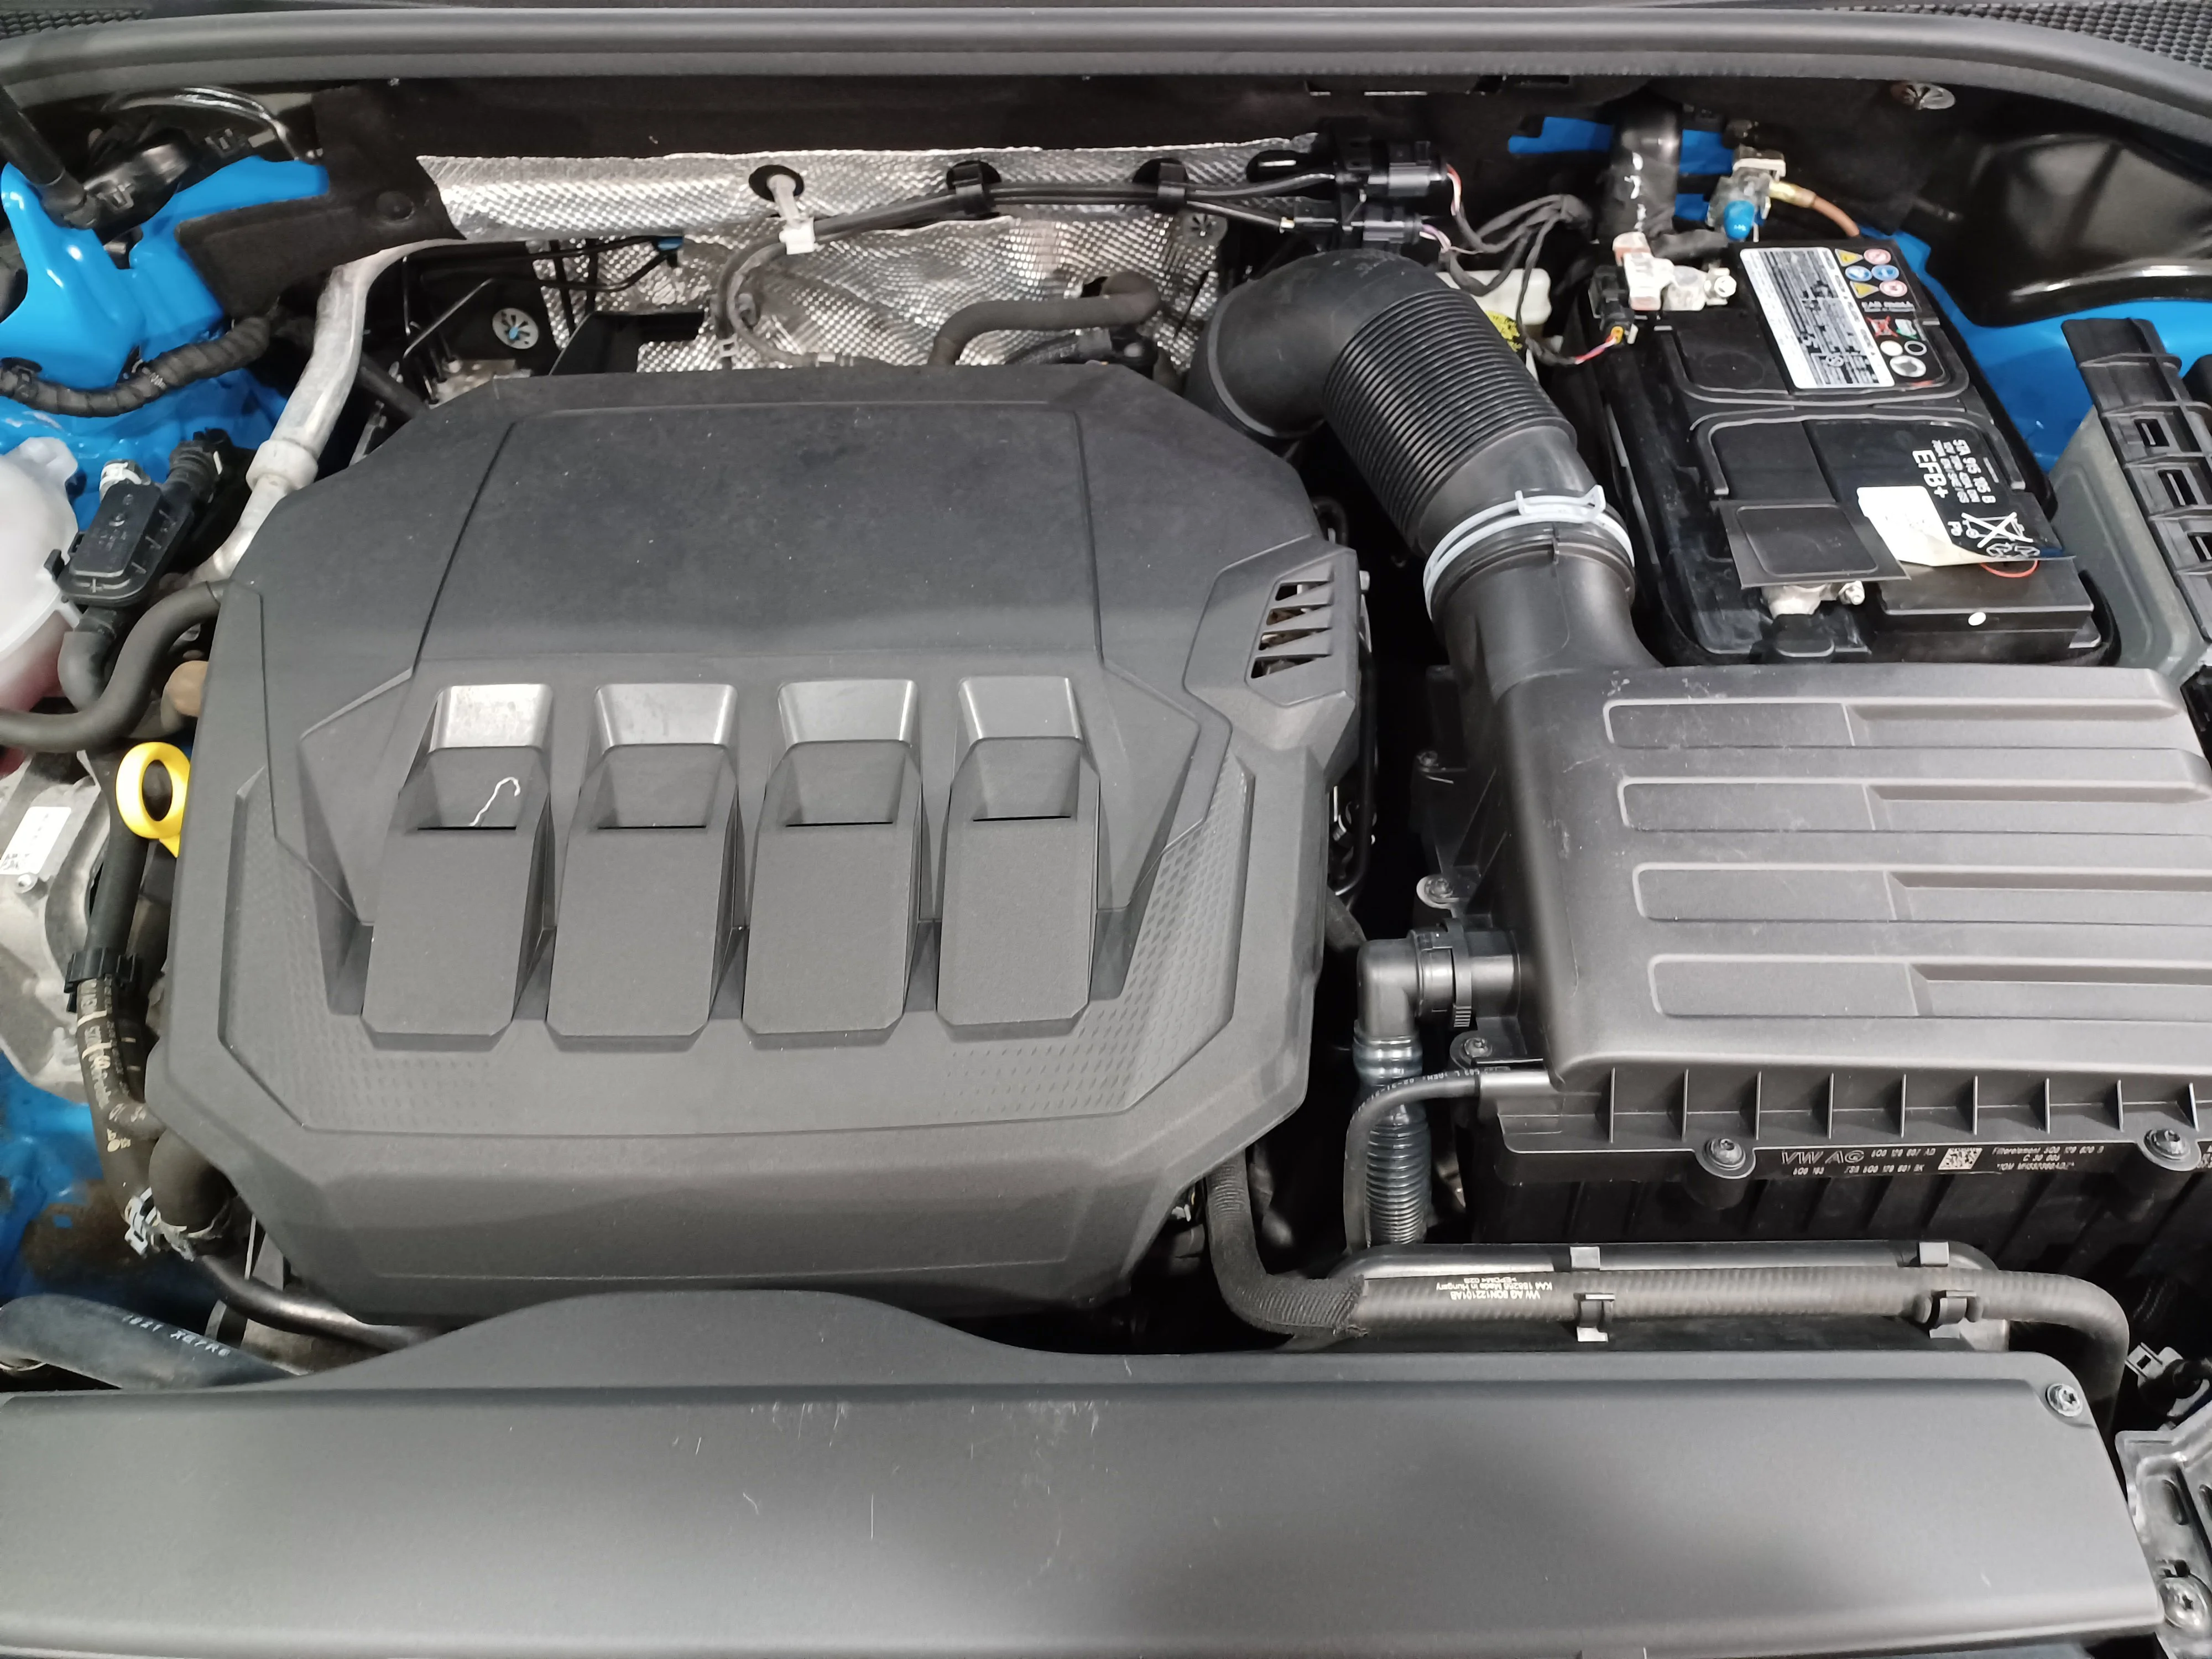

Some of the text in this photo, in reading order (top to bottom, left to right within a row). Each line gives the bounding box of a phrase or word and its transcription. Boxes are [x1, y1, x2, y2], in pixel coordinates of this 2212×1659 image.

[1912, 450, 1948, 498] EFB+
[1781, 1151, 1824, 1165] VW
[1436, 1282, 1470, 1291] Hungary
[1525, 1290, 1541, 1300] VW
